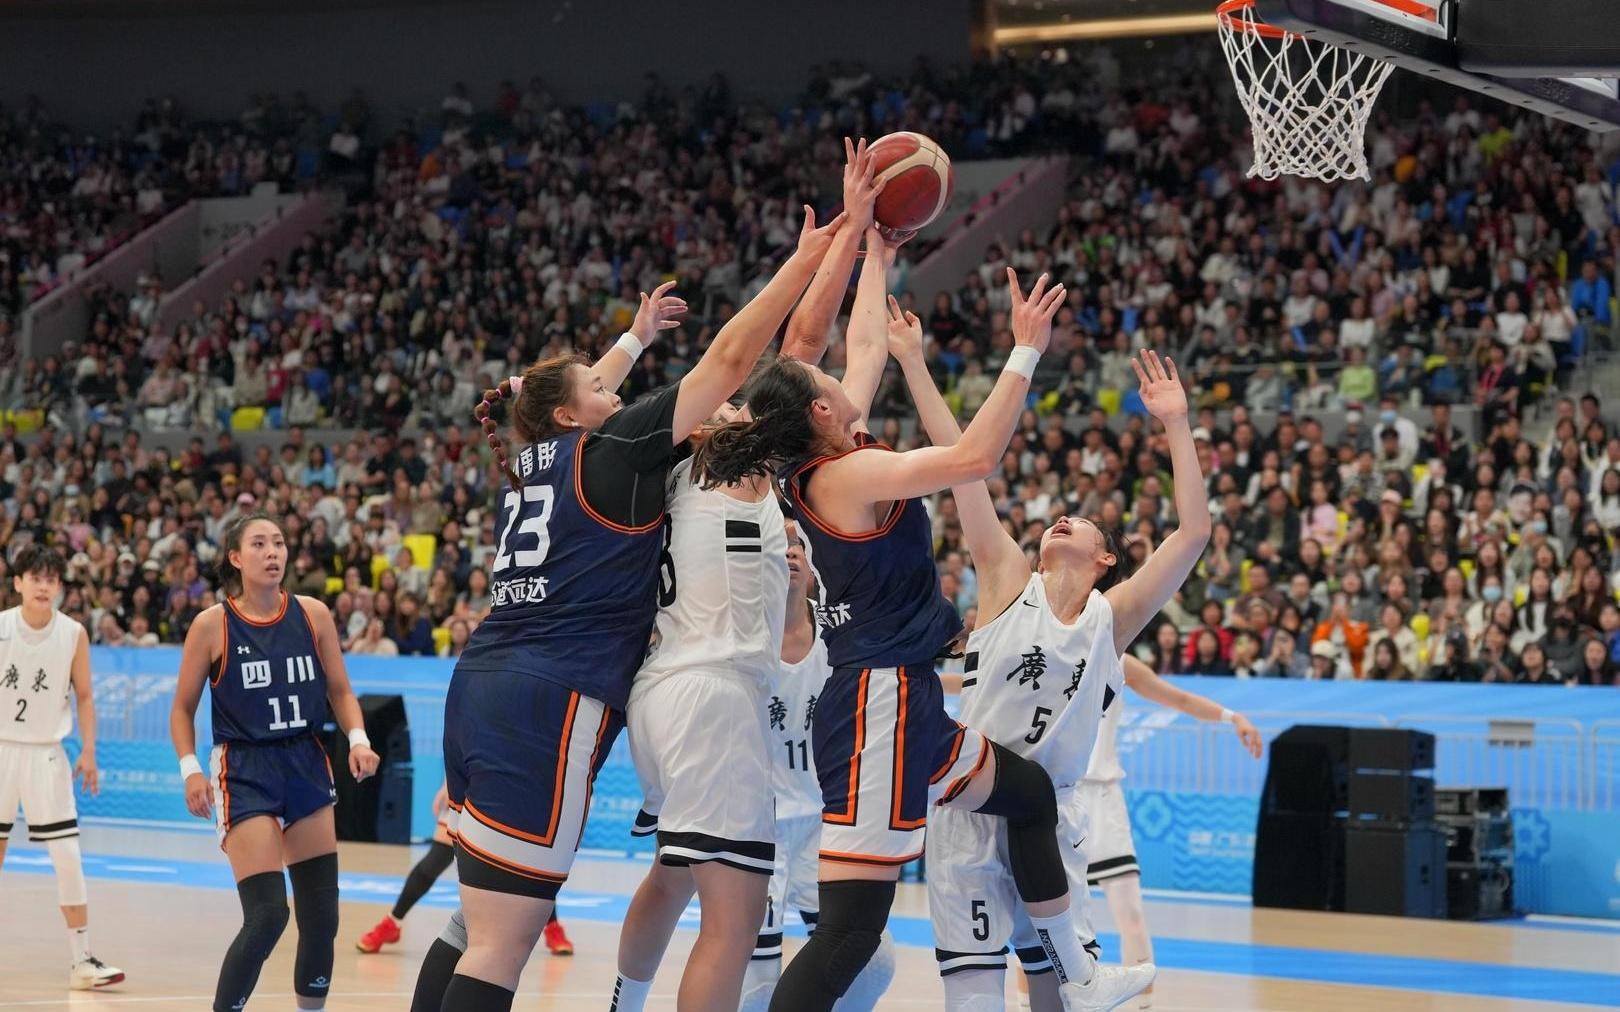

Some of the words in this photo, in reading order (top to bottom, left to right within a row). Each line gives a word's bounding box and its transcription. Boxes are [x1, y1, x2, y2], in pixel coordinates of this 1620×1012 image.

[493, 484, 554, 573] 23
[490, 576, 549, 608] 道远达
[0, 664, 48, 692] 廣東
[241, 655, 315, 690] 四川
[15, 698, 27, 722] 2
[268, 694, 308, 731] 11
[1024, 705, 1053, 744] 5
[784, 739, 809, 771] 11
[971, 900, 990, 942] 5
